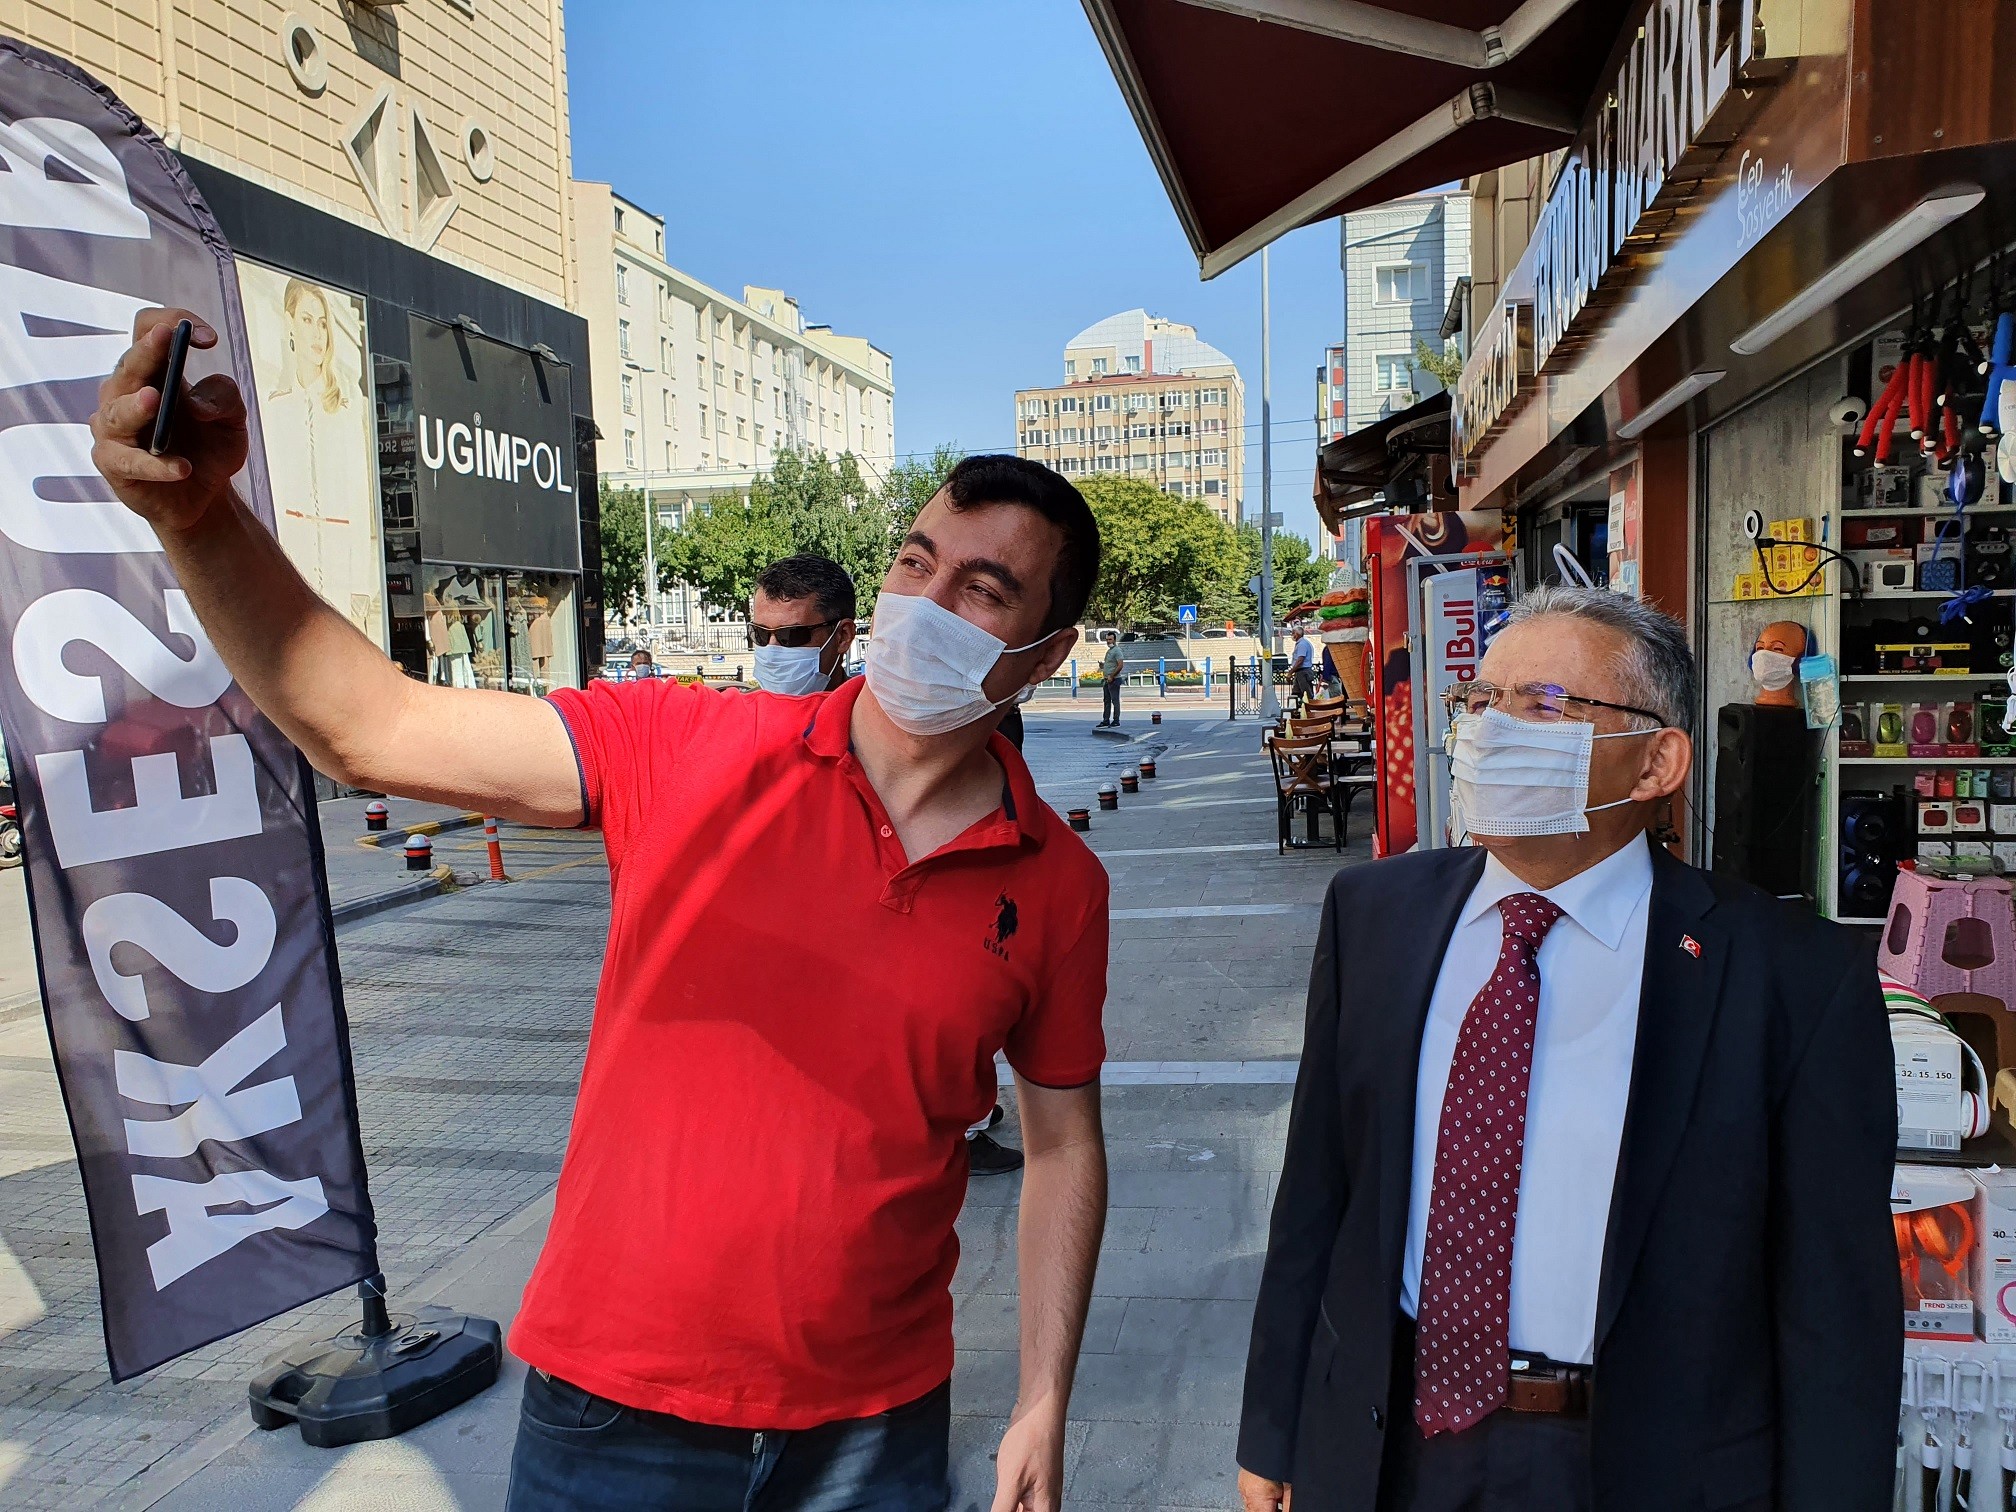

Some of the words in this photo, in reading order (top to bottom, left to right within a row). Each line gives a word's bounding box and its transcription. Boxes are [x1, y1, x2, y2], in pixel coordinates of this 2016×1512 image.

[1737, 163, 1794, 249] Sosyetik
[1738, 149, 1764, 209] Cep
[1443, 600, 1476, 659] Bull
[1901, 1070, 1913, 1078] 32
[1919, 1071, 1930, 1079] 15
[1936, 1072, 1952, 1080] 150
[1993, 1230, 2006, 1239] 40
